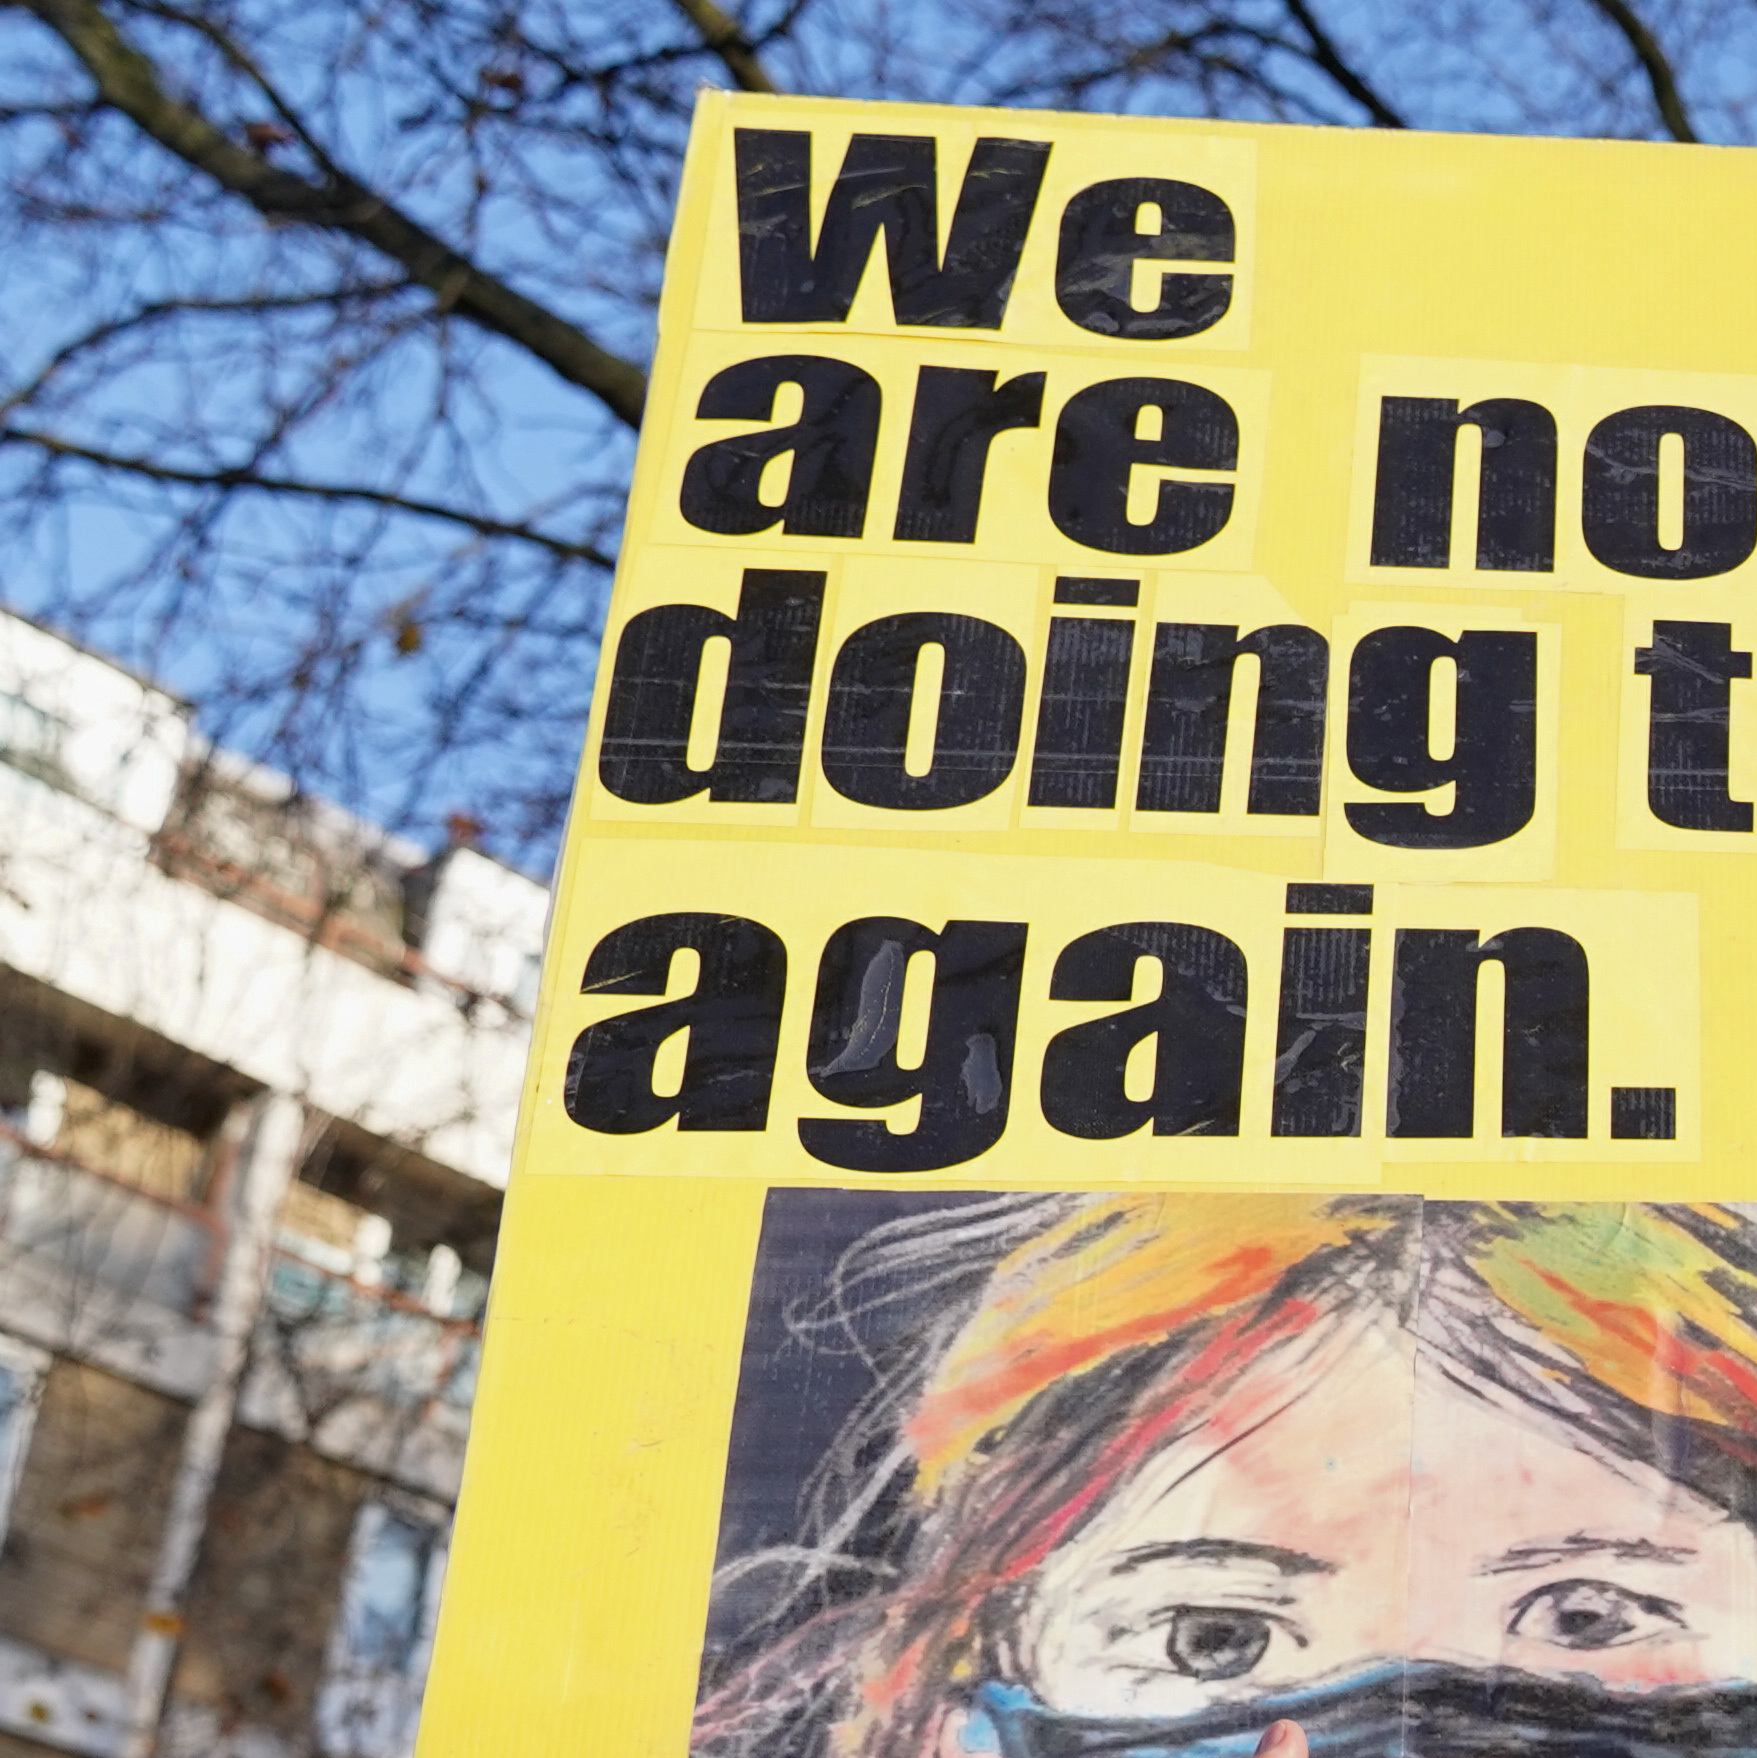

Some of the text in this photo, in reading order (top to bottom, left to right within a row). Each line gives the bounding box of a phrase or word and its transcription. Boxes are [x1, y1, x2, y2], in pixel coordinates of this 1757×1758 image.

[733, 128, 1236, 341] We
[679, 354, 1239, 556] are
[598, 568, 1538, 850] doing
[564, 883, 1677, 1173] again.
